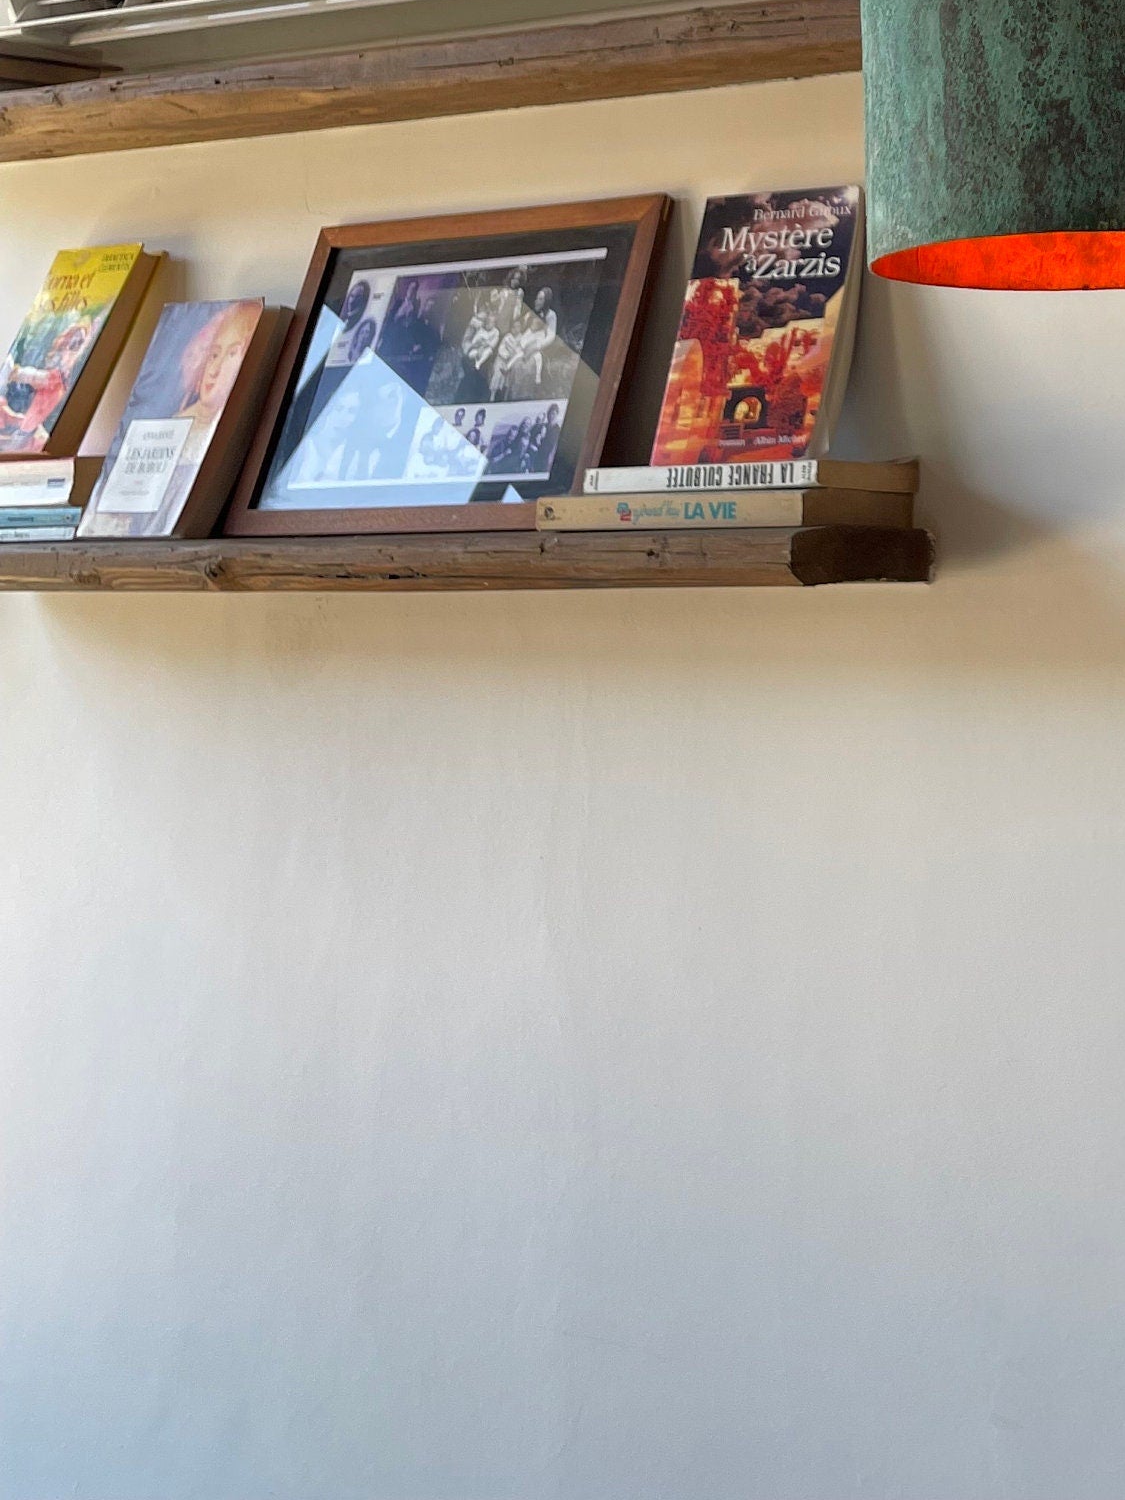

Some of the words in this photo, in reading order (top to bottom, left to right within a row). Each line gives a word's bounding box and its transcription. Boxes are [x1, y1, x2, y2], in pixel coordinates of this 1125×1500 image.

[754, 206, 806, 221] Bernard
[719, 223, 834, 254] Mystère
[752, 251, 841, 280] Zarzis
[728, 463, 774, 486] FRANCE
[780, 462, 795, 484] LA
[683, 501, 706, 520] LA
[706, 501, 738, 520] VIE
